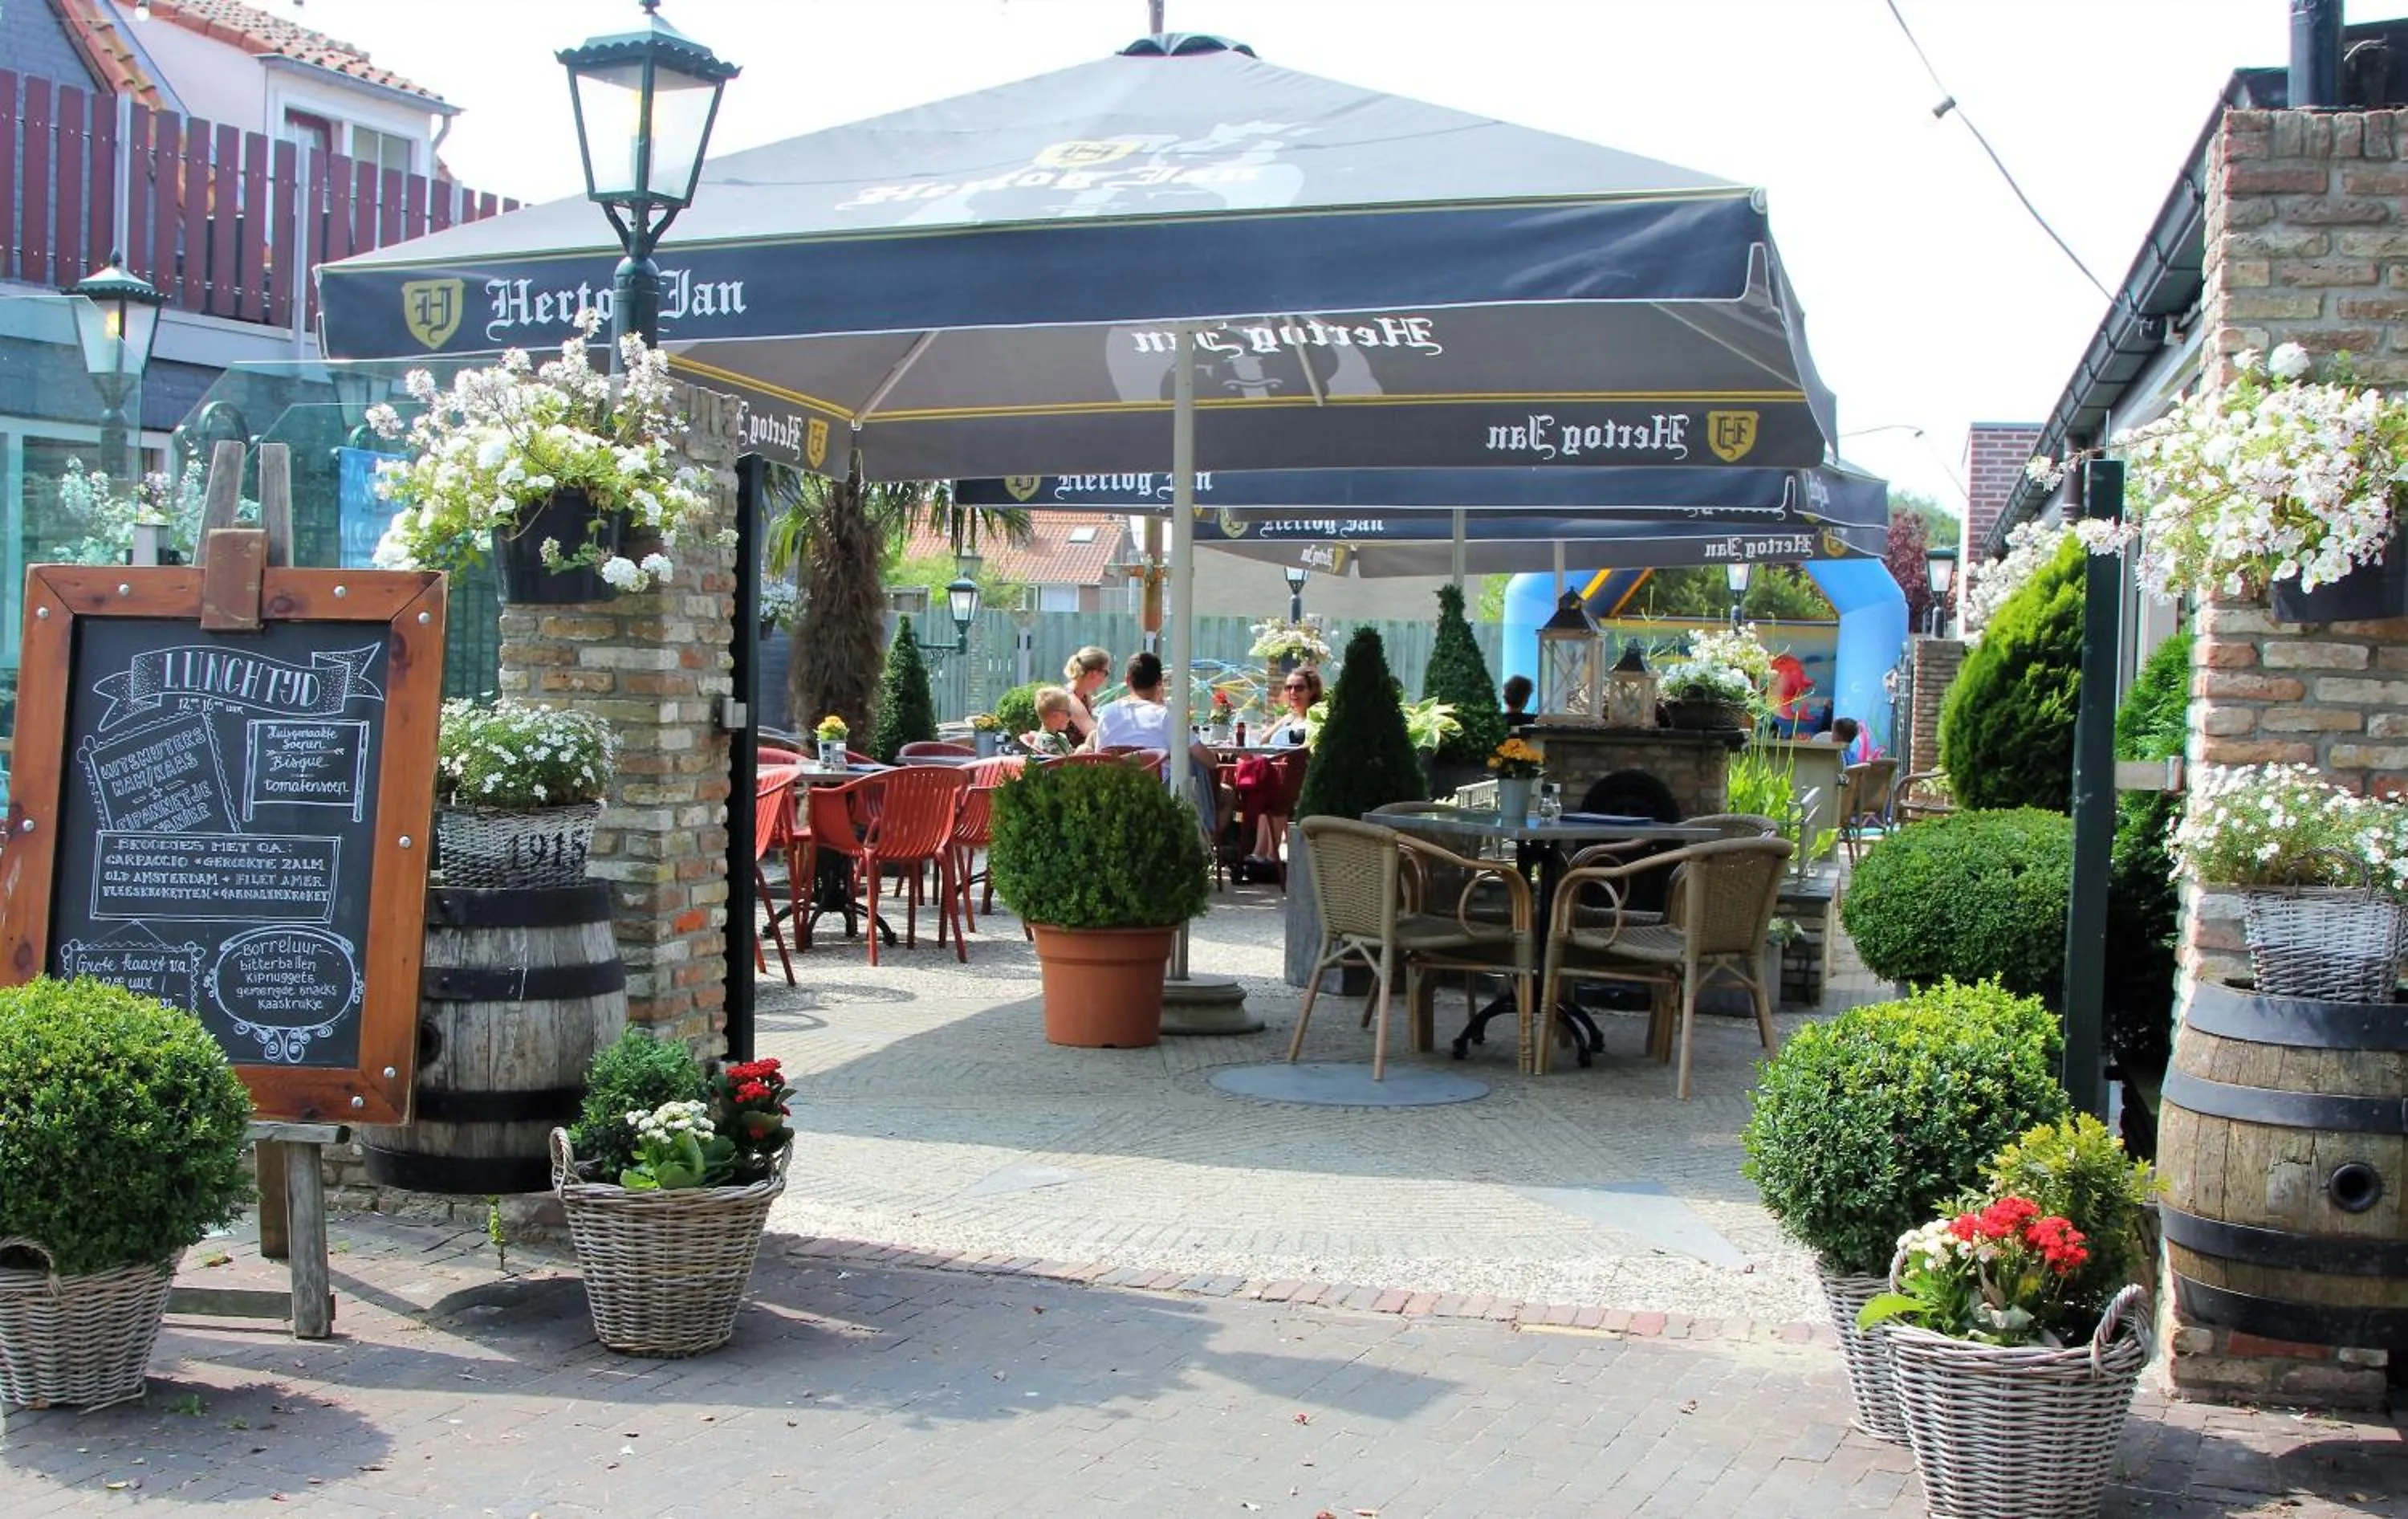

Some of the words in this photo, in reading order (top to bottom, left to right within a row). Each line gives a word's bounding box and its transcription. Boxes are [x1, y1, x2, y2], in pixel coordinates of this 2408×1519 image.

[485, 279, 615, 341] Herto
[211, 842, 250, 853] MET
[104, 853, 189, 869] CARPACCIO
[132, 871, 219, 886] AMSTERDAM
